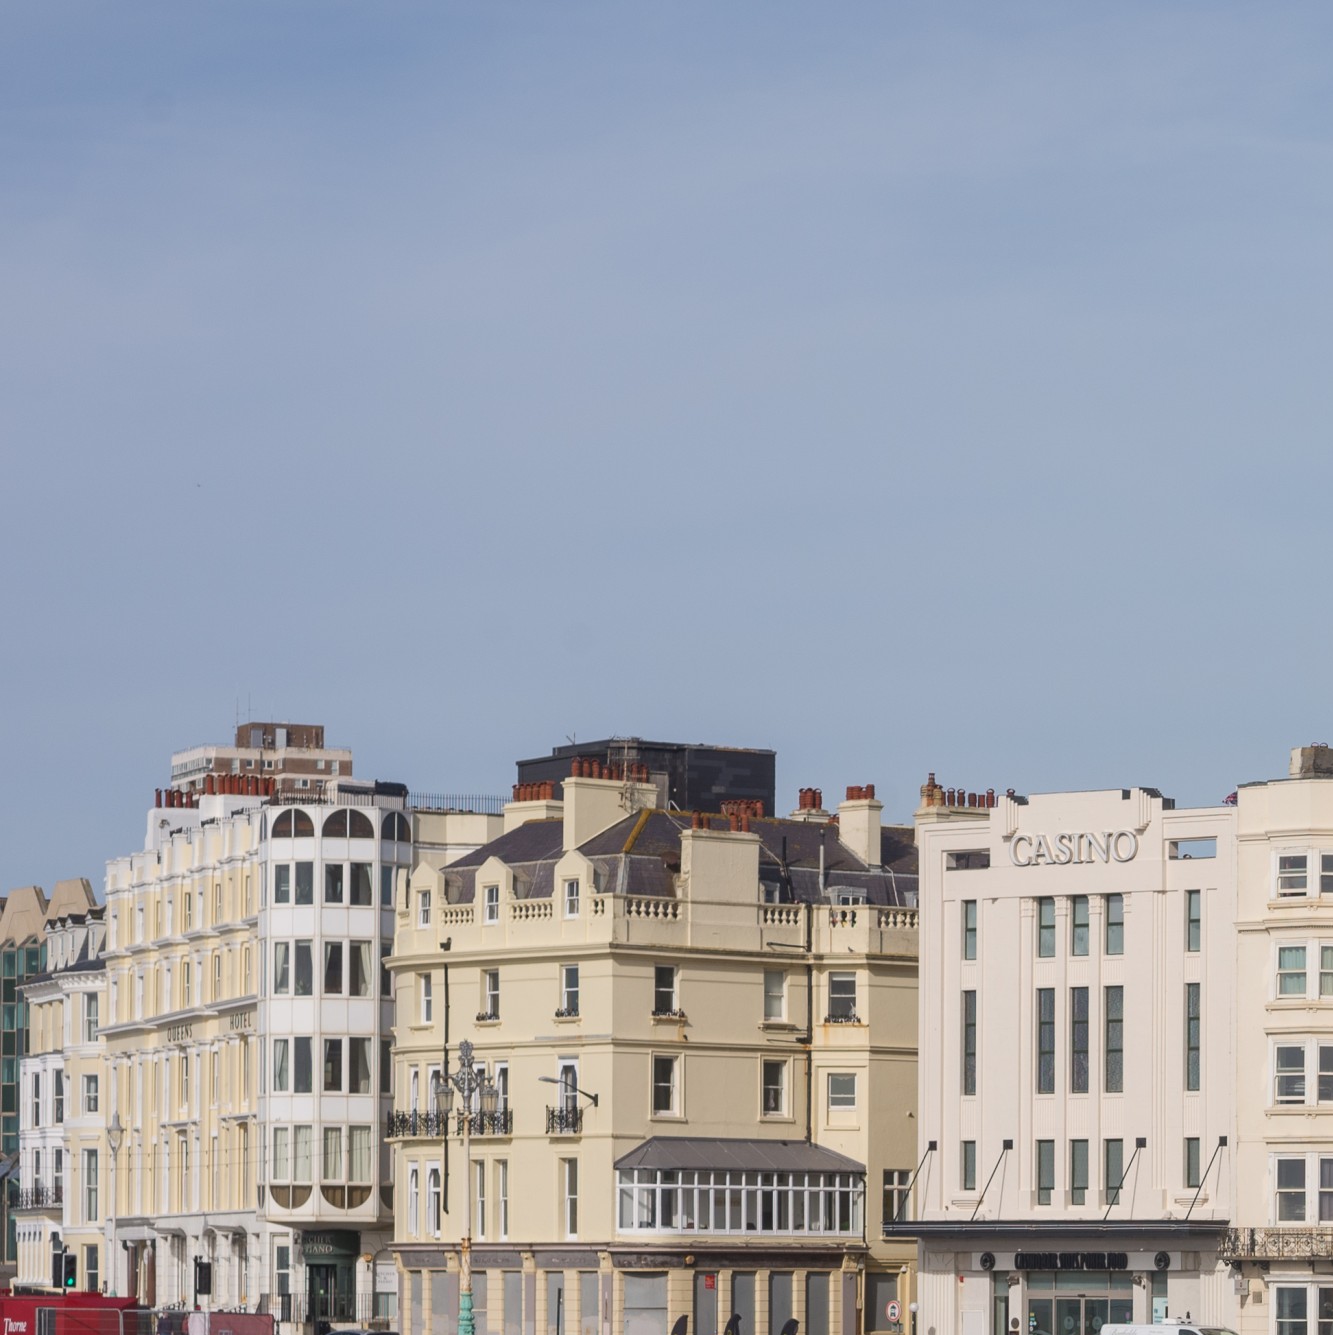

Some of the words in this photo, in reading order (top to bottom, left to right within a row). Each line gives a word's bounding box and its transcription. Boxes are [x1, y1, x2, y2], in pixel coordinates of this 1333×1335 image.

[1009, 830, 1139, 867] CASINO
[167, 1023, 193, 1042] QUEENS
[229, 1011, 252, 1031] HOTEL
